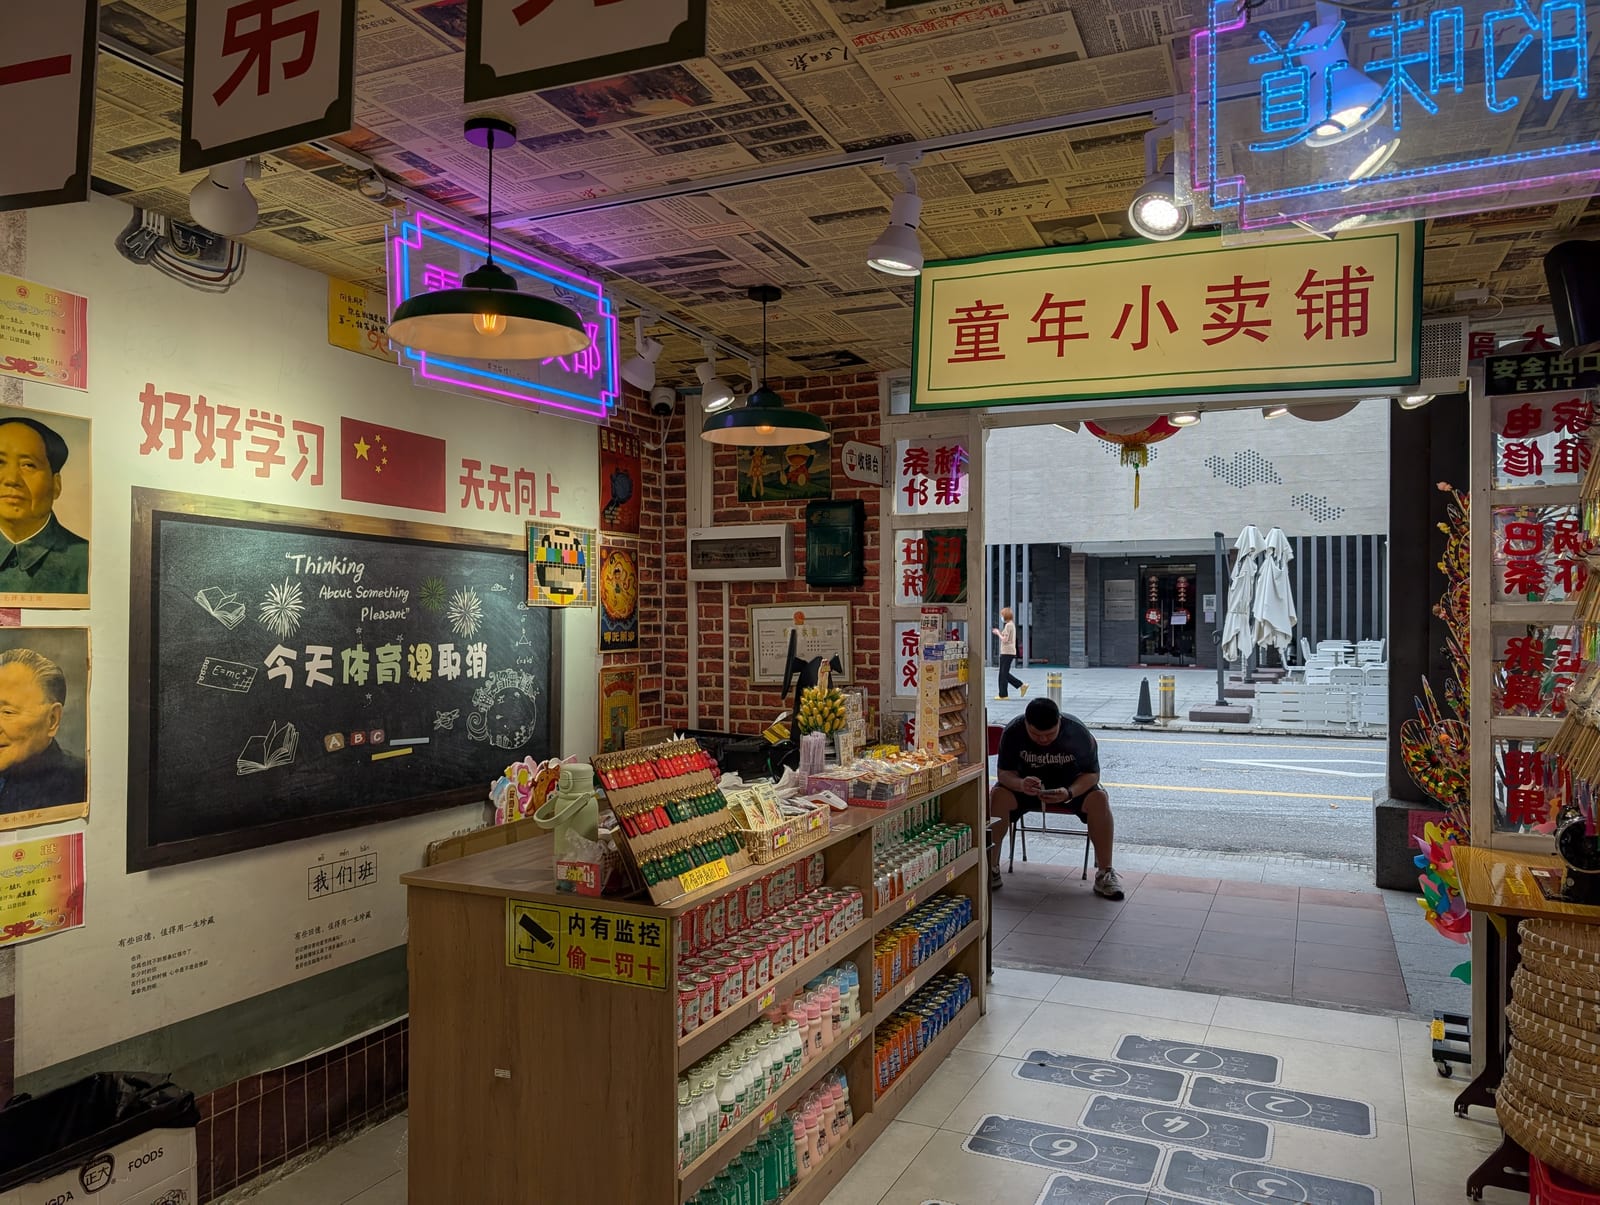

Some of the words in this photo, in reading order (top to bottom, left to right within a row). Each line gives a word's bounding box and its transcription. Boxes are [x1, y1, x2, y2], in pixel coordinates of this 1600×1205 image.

[946, 264, 1375, 364] 童年小卖铺
[1493, 352, 1600, 379] 安全出口
[1516, 376, 1576, 391] EXIT
[139, 382, 325, 486] 好好学习
[857, 453, 879, 475] 收银台
[459, 457, 561, 519] 天天向上
[319, 584, 352, 600] About
[355, 584, 410, 602] Something
[263, 641, 488, 690] 今天体育课取消
[313, 860, 374, 892] 我们班
[567, 912, 661, 948] 内有监控
[567, 944, 661, 981] 偷一罚十
[128, 1147, 164, 1172] FOODS
